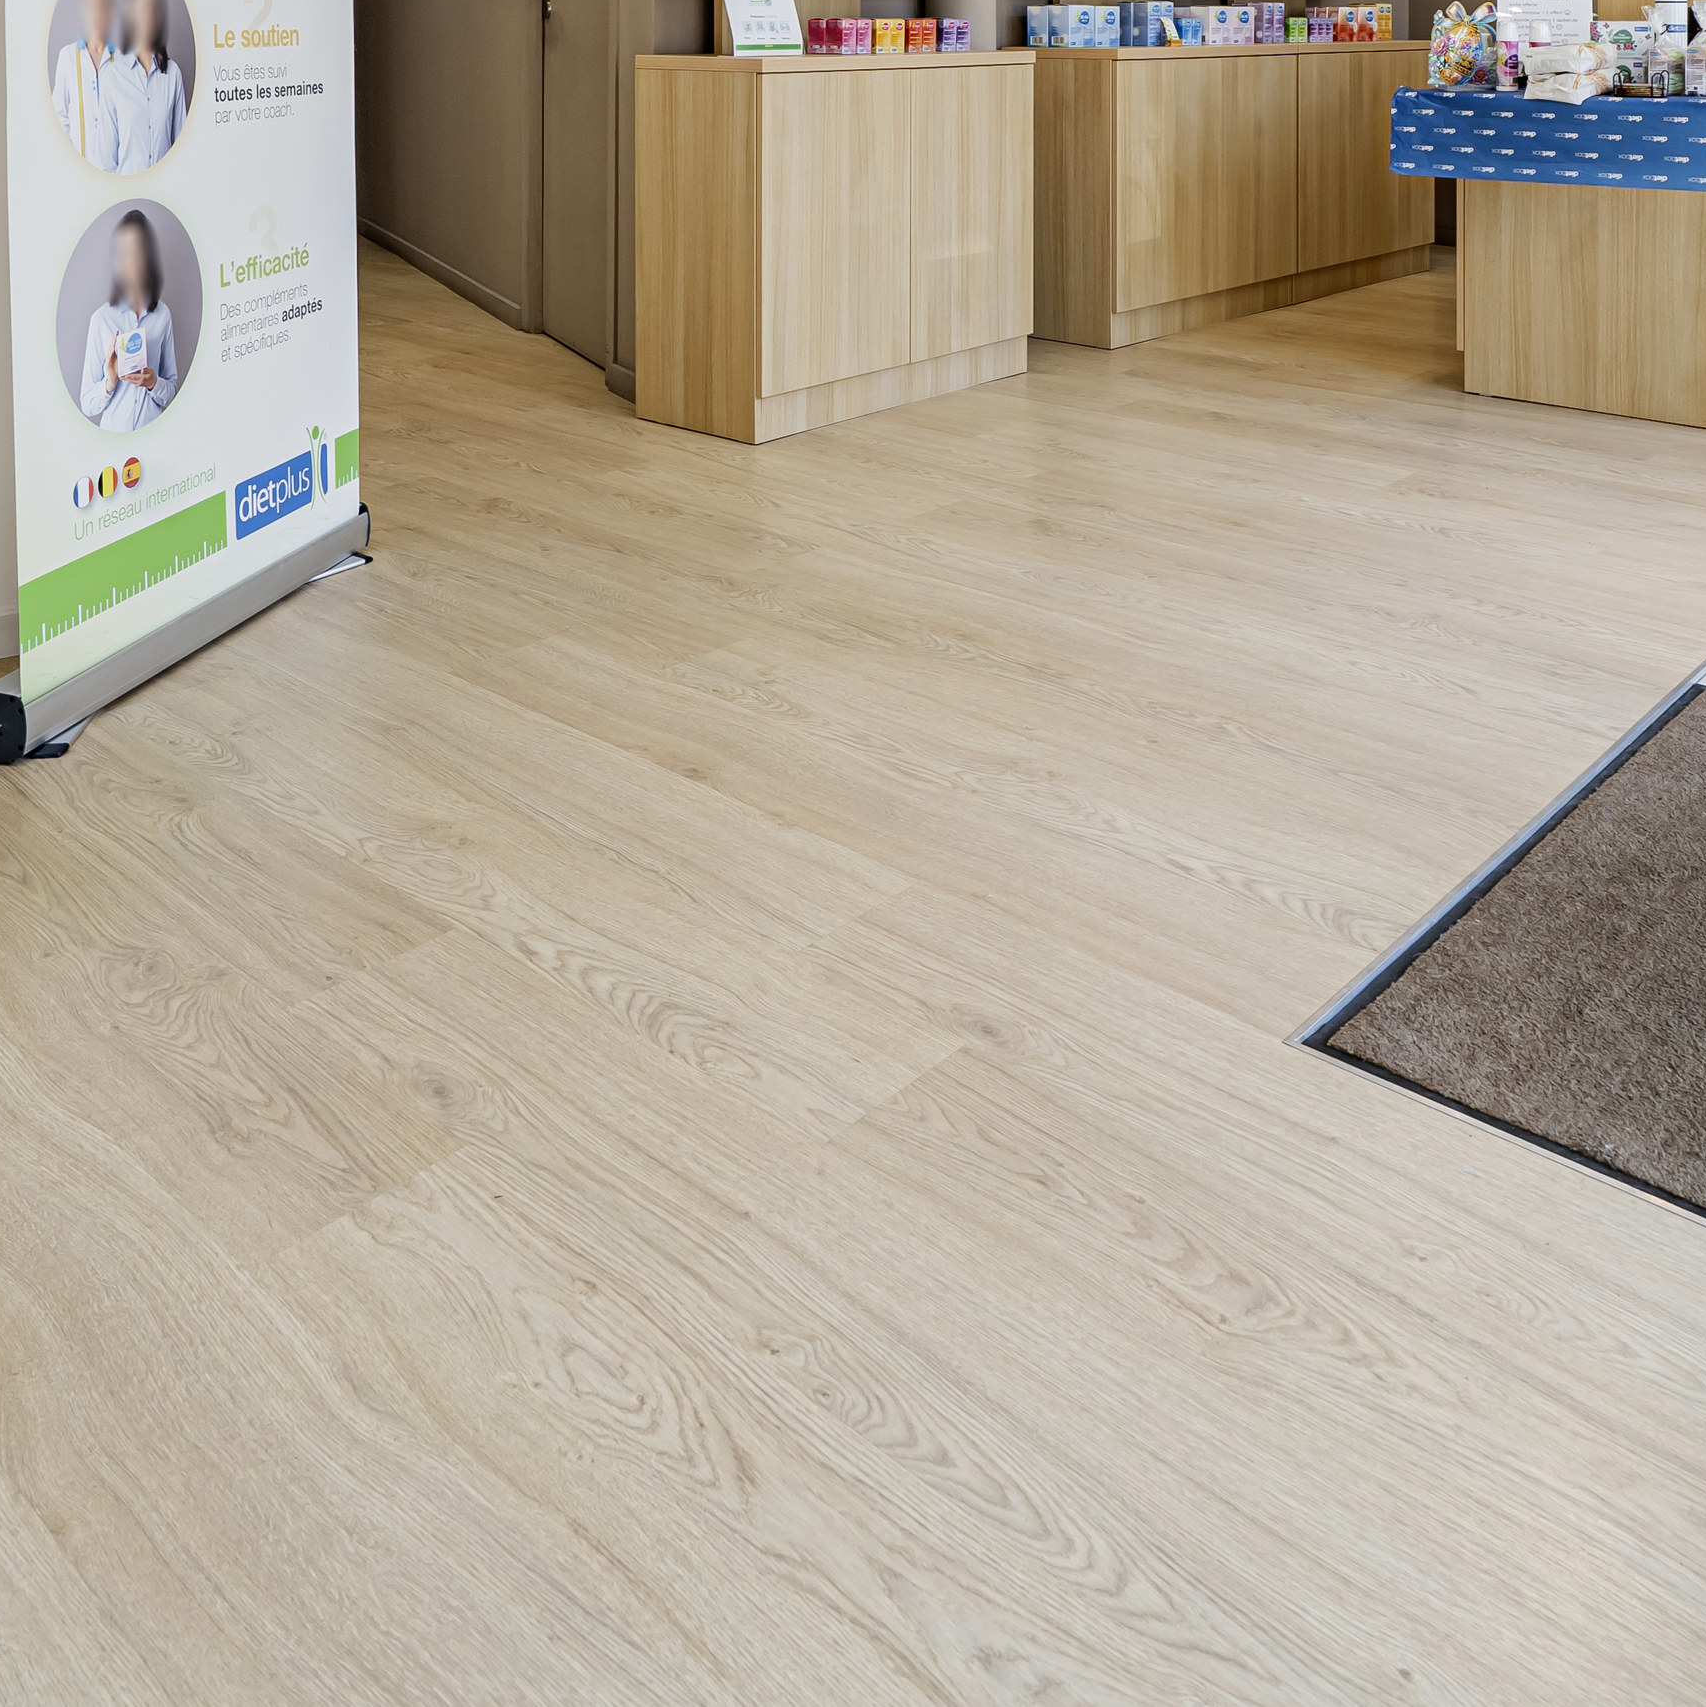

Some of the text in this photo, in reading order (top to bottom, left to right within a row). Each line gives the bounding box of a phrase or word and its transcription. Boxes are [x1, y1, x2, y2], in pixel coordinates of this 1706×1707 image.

[214, 24, 300, 49] Le soutien
[213, 62, 287, 82] Vous êtes suivi
[214, 81, 324, 102] toutes les semaines
[215, 102, 295, 127] par votre coach.
[220, 243, 310, 288] L'efficacité
[220, 283, 309, 321] Des compléments
[221, 297, 323, 342] alimentaires adaptés
[221, 329, 291, 363] et spécifiques.
[73, 463, 217, 541] Un réseau international
[238, 465, 311, 523] dietplus
